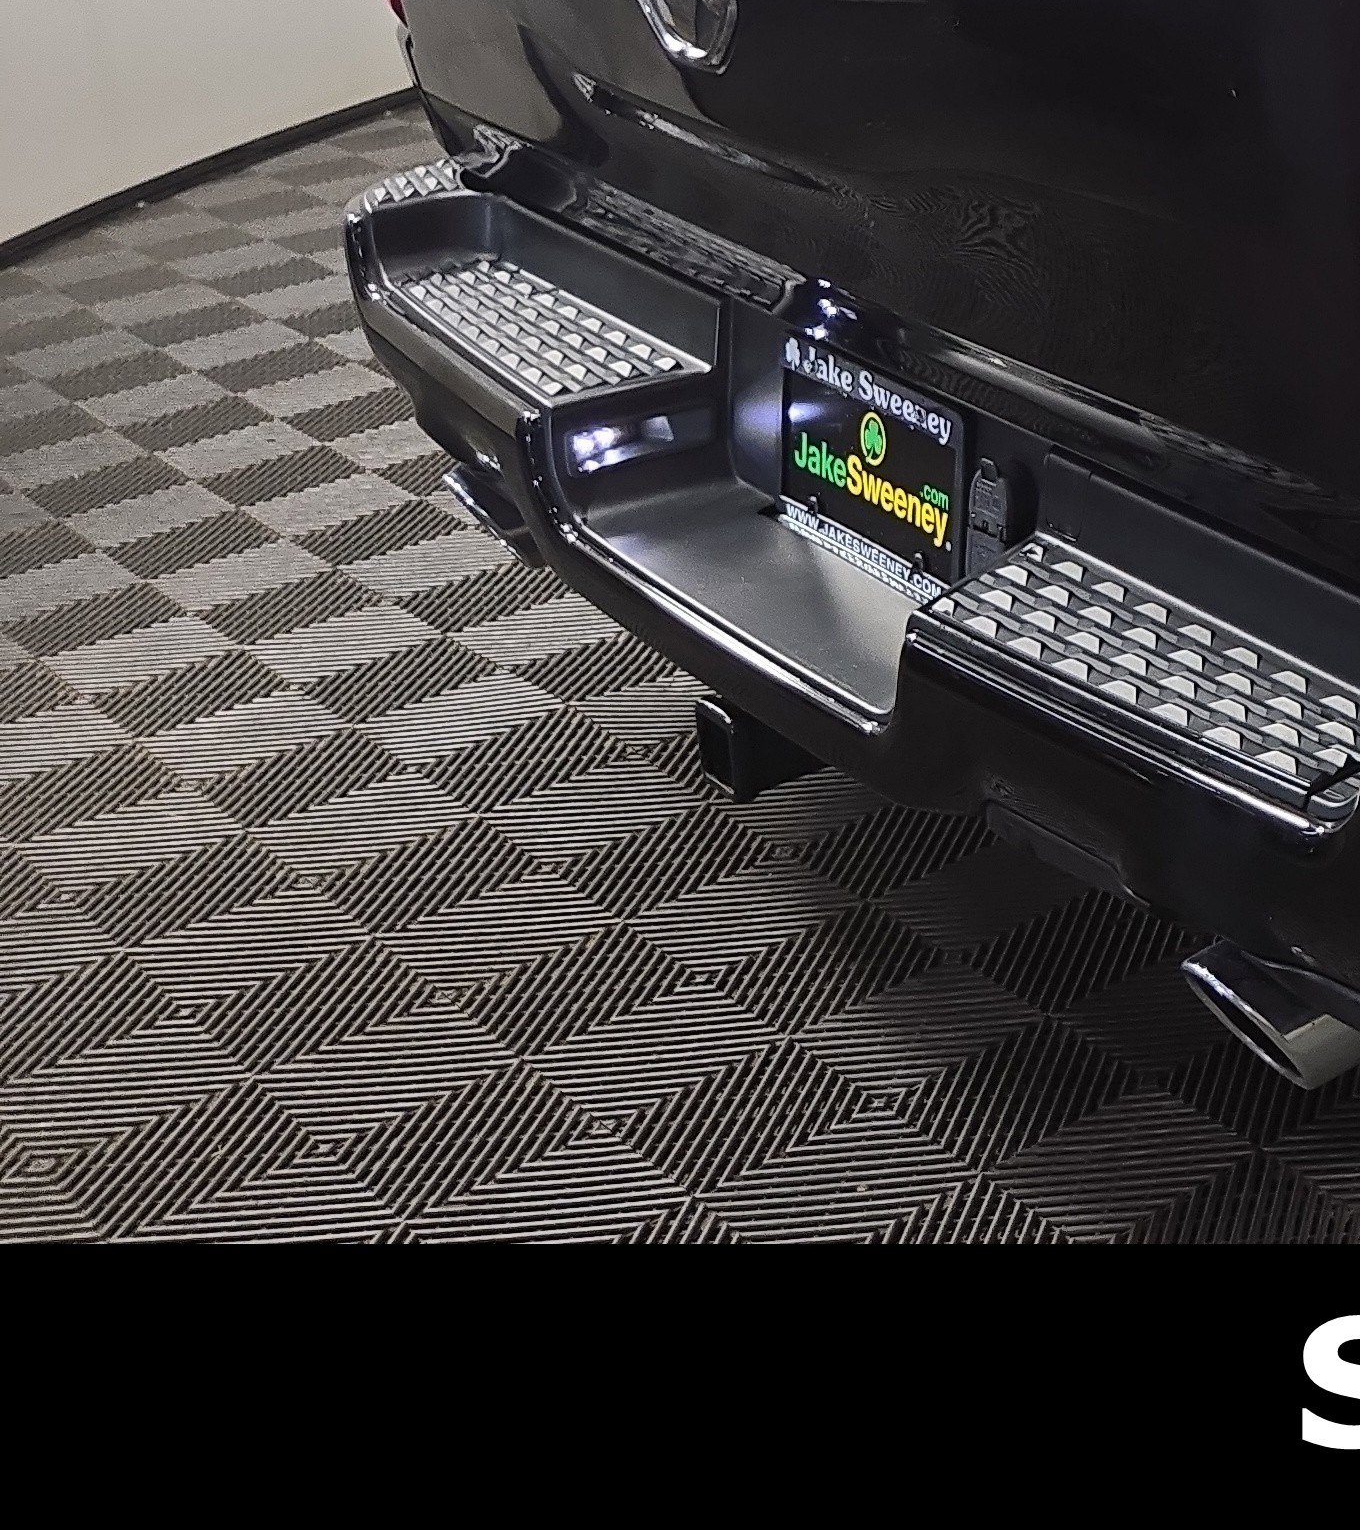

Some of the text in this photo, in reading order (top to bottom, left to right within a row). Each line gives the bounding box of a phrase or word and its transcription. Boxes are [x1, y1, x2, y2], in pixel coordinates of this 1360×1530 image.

[802, 345, 952, 446] Jake Sweeney
[785, 503, 942, 599] WWW.JAKESWEENEY.COM
